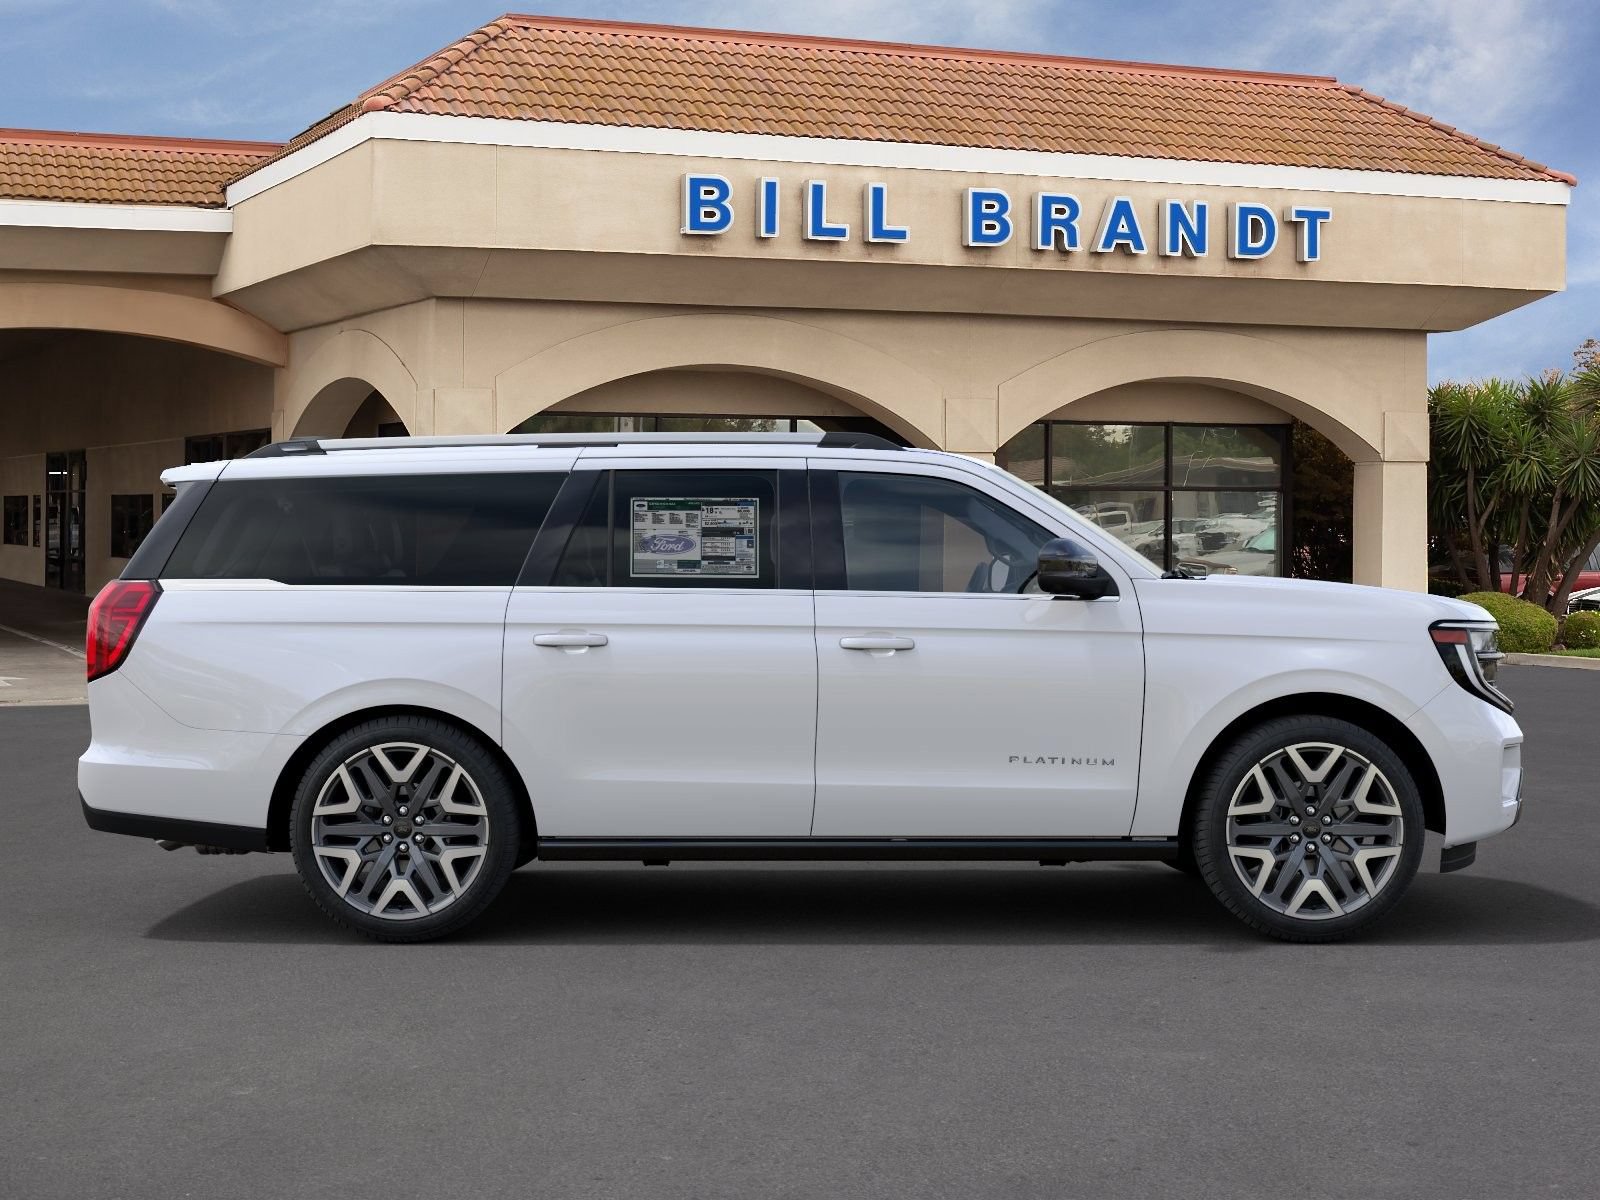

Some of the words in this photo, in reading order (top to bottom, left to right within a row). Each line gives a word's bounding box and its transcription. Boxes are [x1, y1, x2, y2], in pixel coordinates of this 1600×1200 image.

[682, 172, 911, 244] BILL
[963, 186, 1333, 263] BRANDT
[650, 537, 685, 551] Ford
[1008, 755, 1116, 767] PLATINUM
